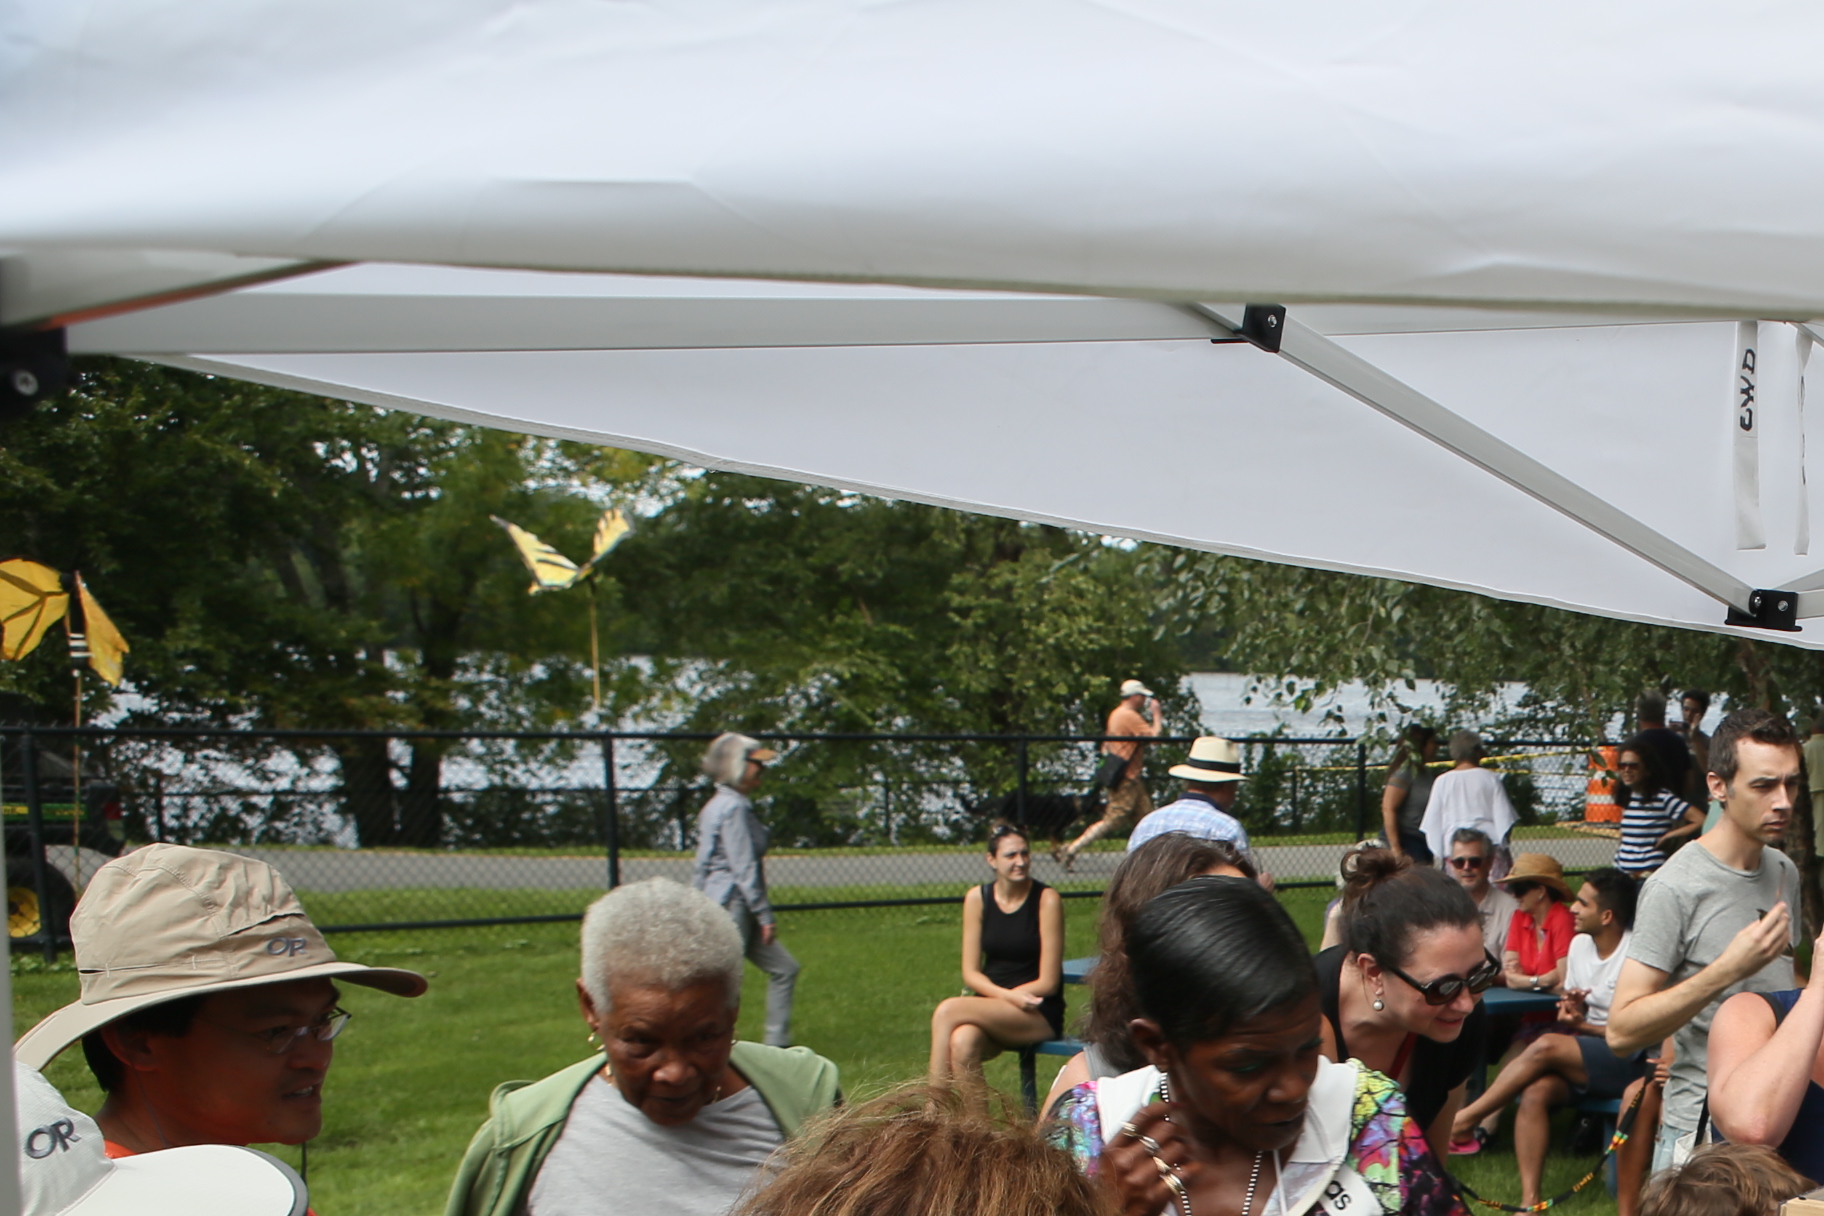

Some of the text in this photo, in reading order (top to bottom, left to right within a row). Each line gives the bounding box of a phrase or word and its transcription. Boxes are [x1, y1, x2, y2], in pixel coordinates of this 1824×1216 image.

[1739, 348, 1757, 431] CWD
[266, 936, 308, 957] OR
[24, 1116, 82, 1160] OR
